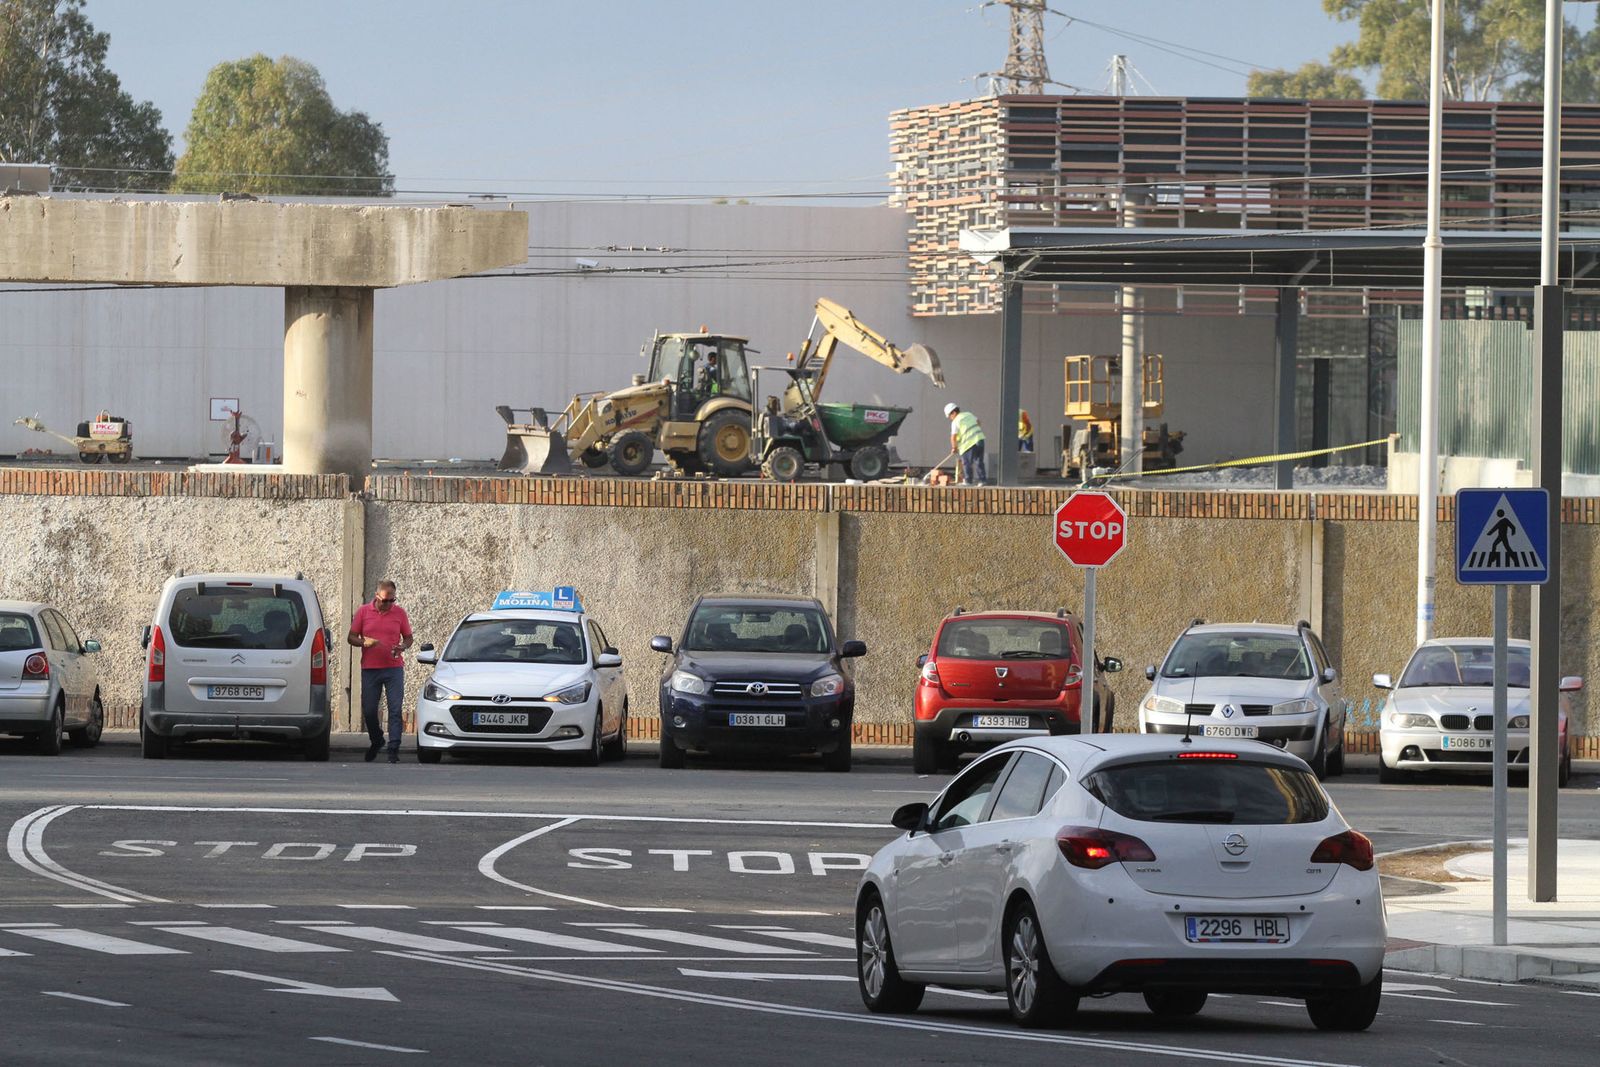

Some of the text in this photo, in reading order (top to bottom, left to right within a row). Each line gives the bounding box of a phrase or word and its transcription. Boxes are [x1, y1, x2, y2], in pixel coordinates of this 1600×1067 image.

[605, 409, 637, 425] KOATSU
[1059, 520, 1121, 540] STOP
[558, 588, 568, 599] L
[214, 686, 262, 697] 9768 GPG
[480, 714, 527, 724] 9446 JKP
[736, 715, 784, 725] 0381 GLH
[980, 716, 1028, 727] 4393 HMB
[1206, 726, 1254, 737] 6760 DWR
[1450, 737, 1476, 748] 5086
[97, 839, 418, 862] STOP
[567, 847, 873, 876] STOP
[1200, 919, 1285, 937] 2296 HBL
